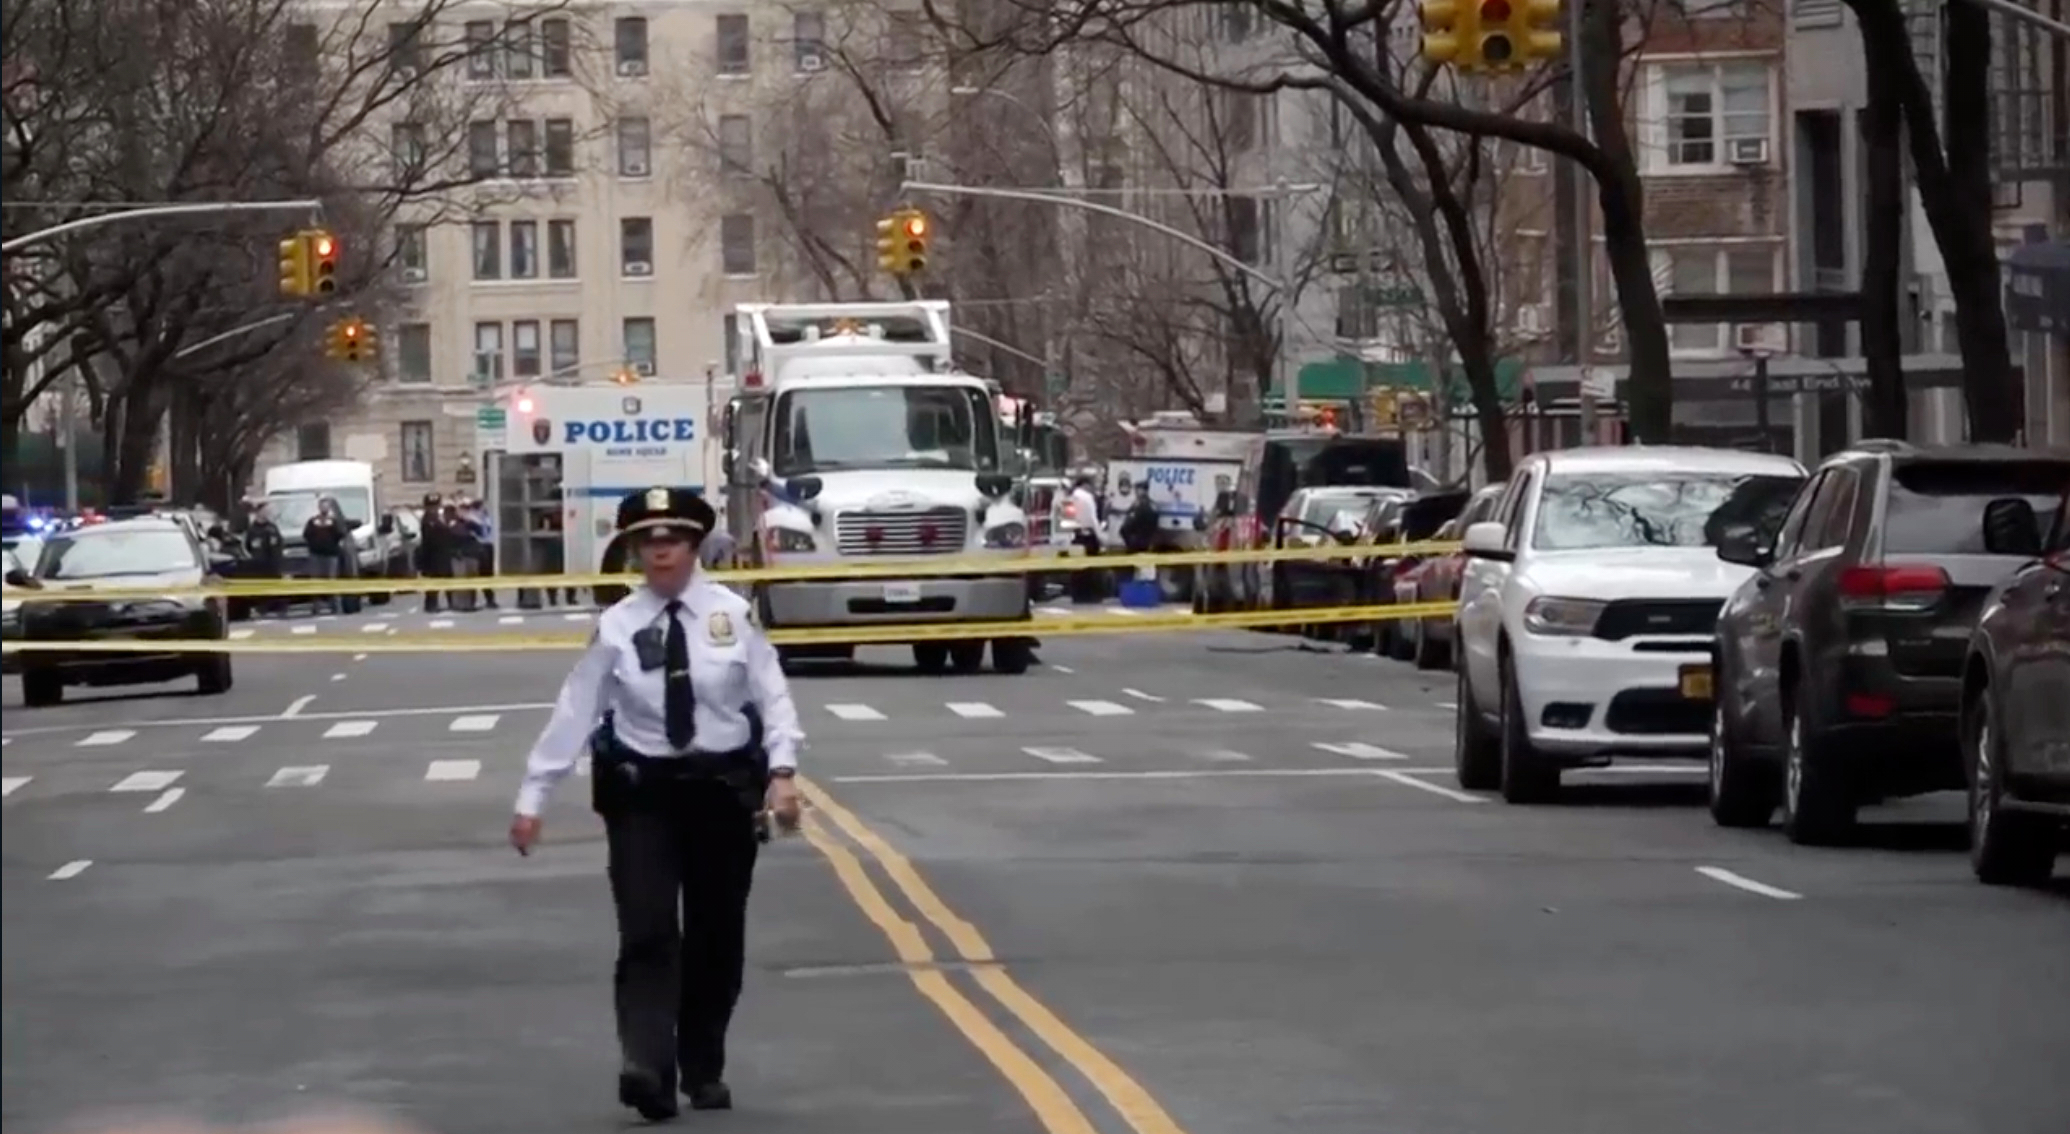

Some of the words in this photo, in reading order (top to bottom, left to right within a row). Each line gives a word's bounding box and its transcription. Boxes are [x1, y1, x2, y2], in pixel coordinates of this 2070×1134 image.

[1803, 376, 1840, 389] End
[566, 418, 694, 443] POLICE
[1147, 467, 1195, 485] POLICE
